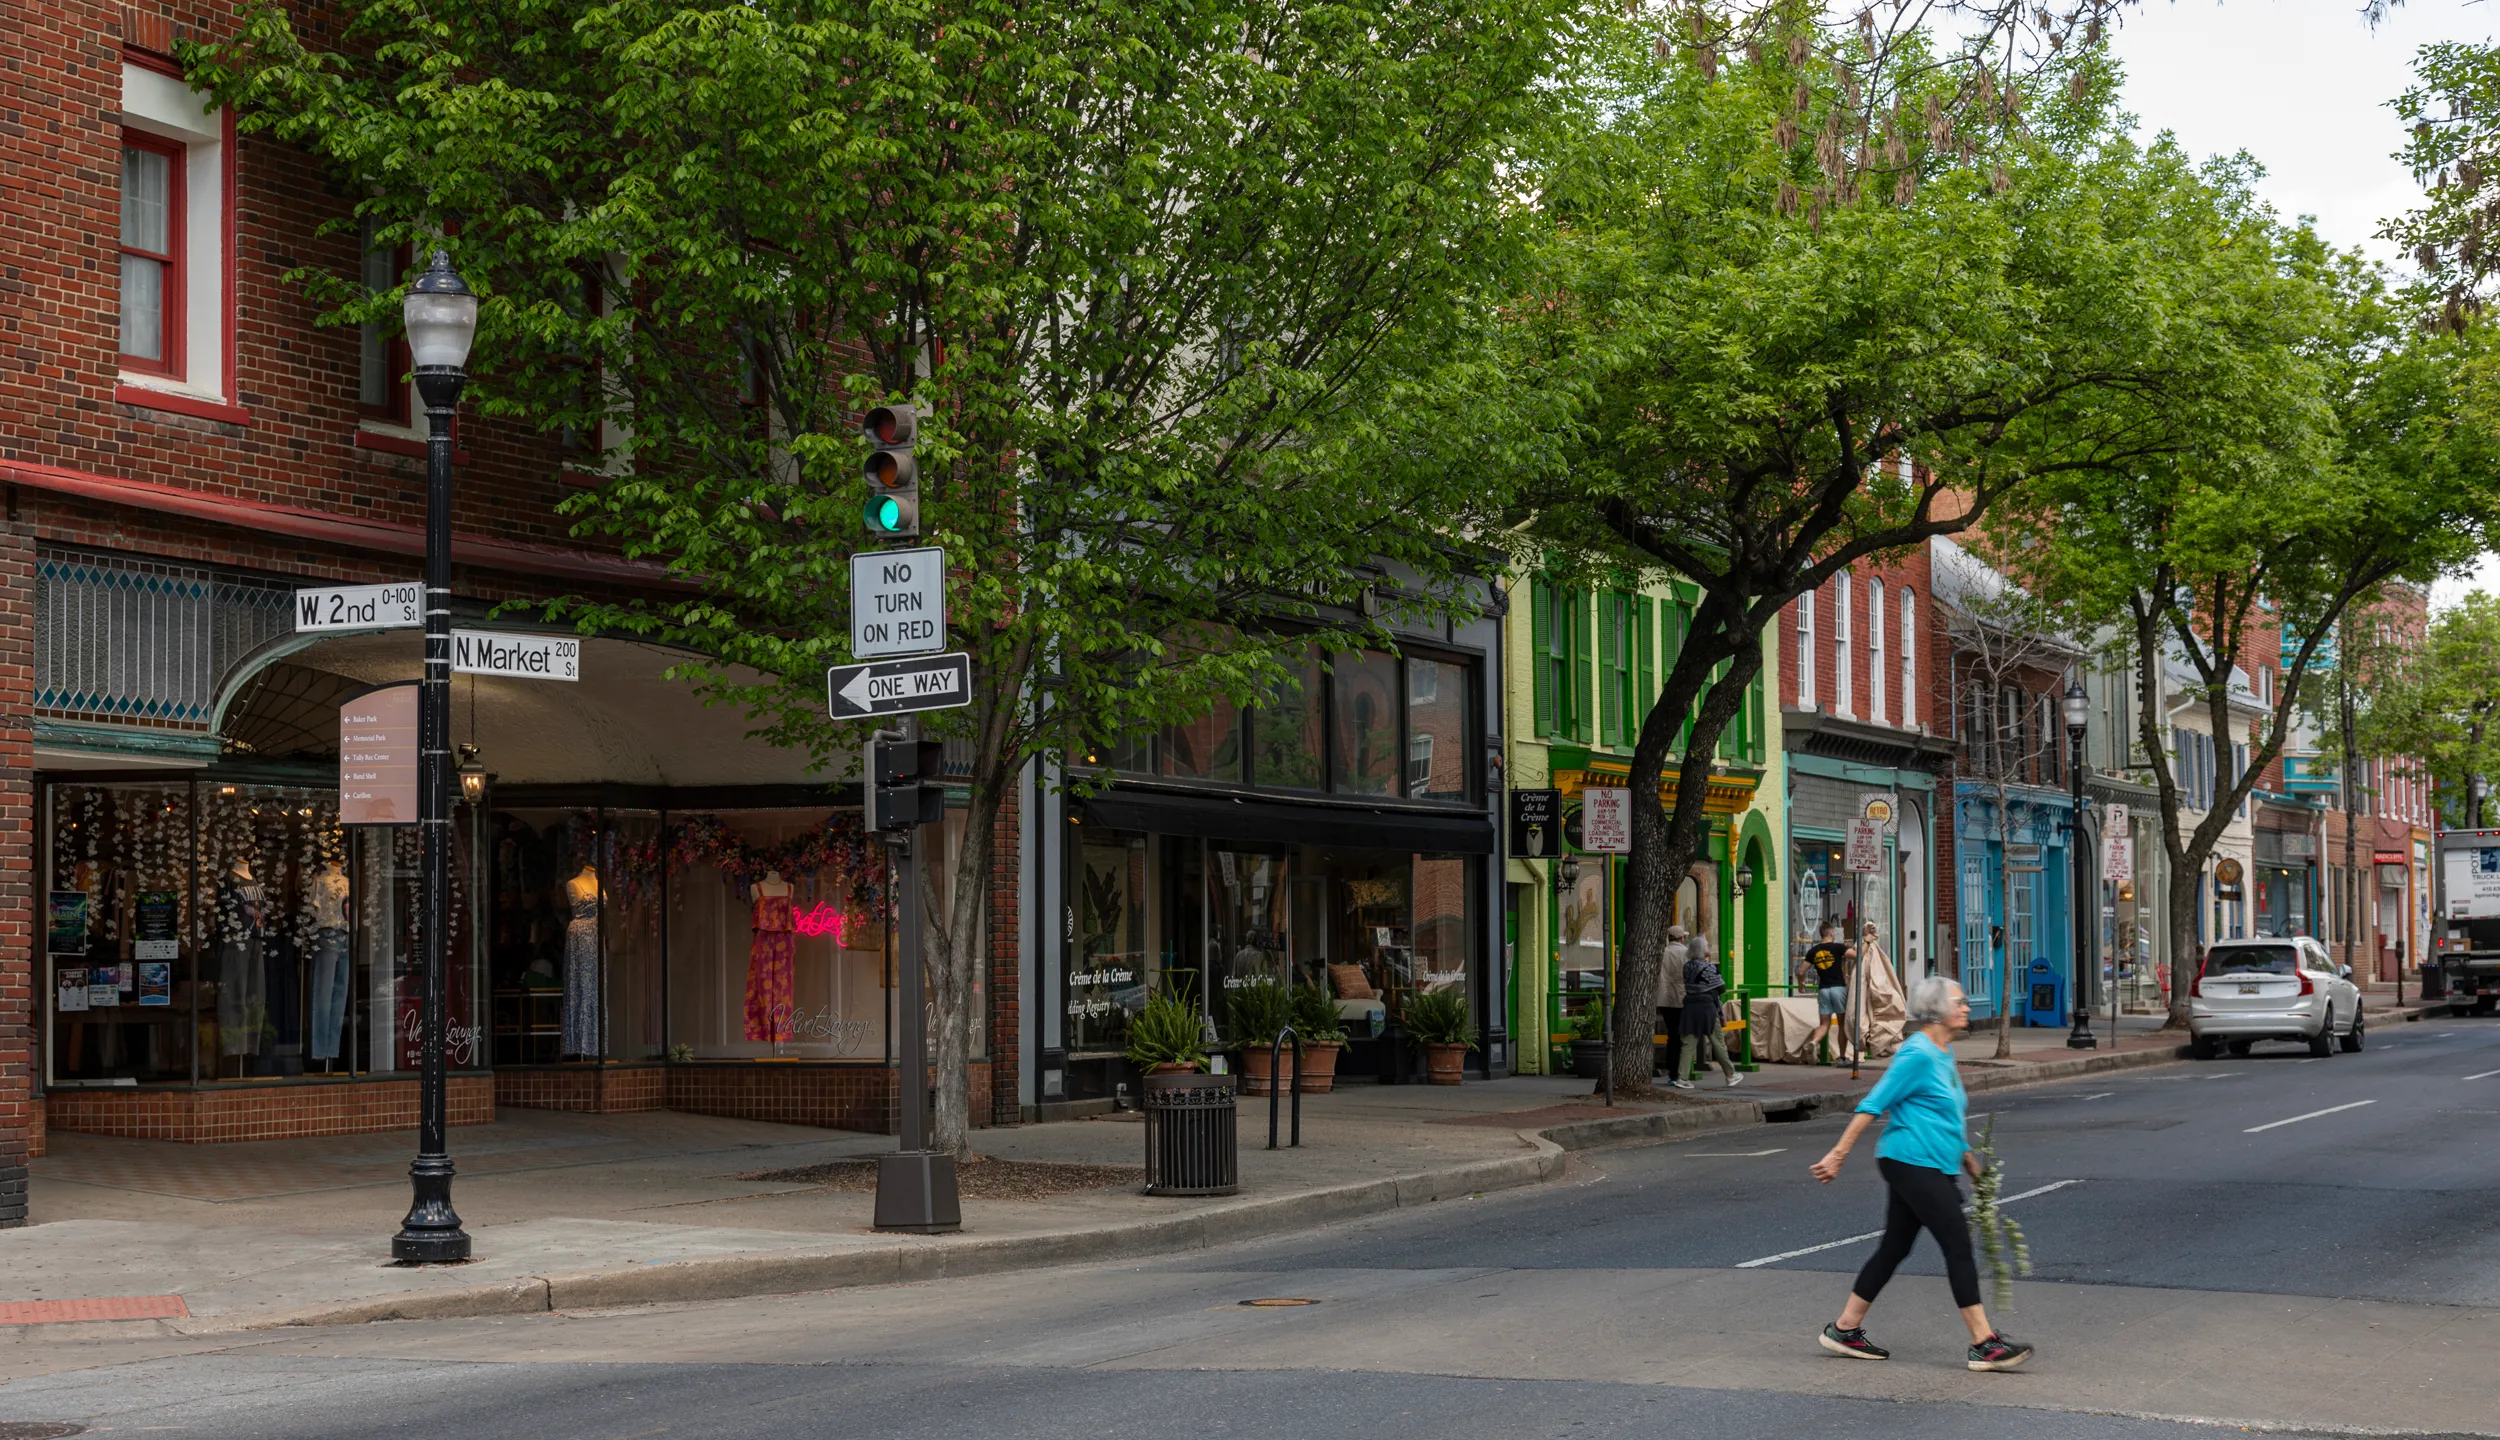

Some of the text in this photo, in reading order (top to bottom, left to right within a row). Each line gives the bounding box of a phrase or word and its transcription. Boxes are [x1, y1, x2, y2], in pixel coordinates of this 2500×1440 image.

[883, 564, 912, 584] NO
[300, 588, 416, 625] W. 2nd 0-100
[874, 592, 922, 613] TURN
[403, 605, 417, 621] St
[863, 620, 934, 643] ON RED
[456, 637, 577, 673] N. Market 200
[565, 661, 576, 678] St
[868, 671, 952, 698] ONE WAY
[353, 734, 375, 742] Memorial
[374, 753, 390, 761] Center
[1520, 793, 1550, 802] Crème
[1601, 790, 1613, 799] NO
[1524, 803, 1546, 812] de la
[1593, 799, 1620, 808] PARKING
[1869, 806, 1888, 815] RETRO
[1520, 813, 1550, 822] Crème
[1854, 827, 1875, 835] PARKING
[51, 911, 83, 919] MAINE
[1069, 968, 1133, 986] Crème de la Crème
[1223, 975, 1242, 989] Crème
[1086, 999, 1111, 1019] Registry
[769, 1003, 876, 1055] Velvet Lounge
